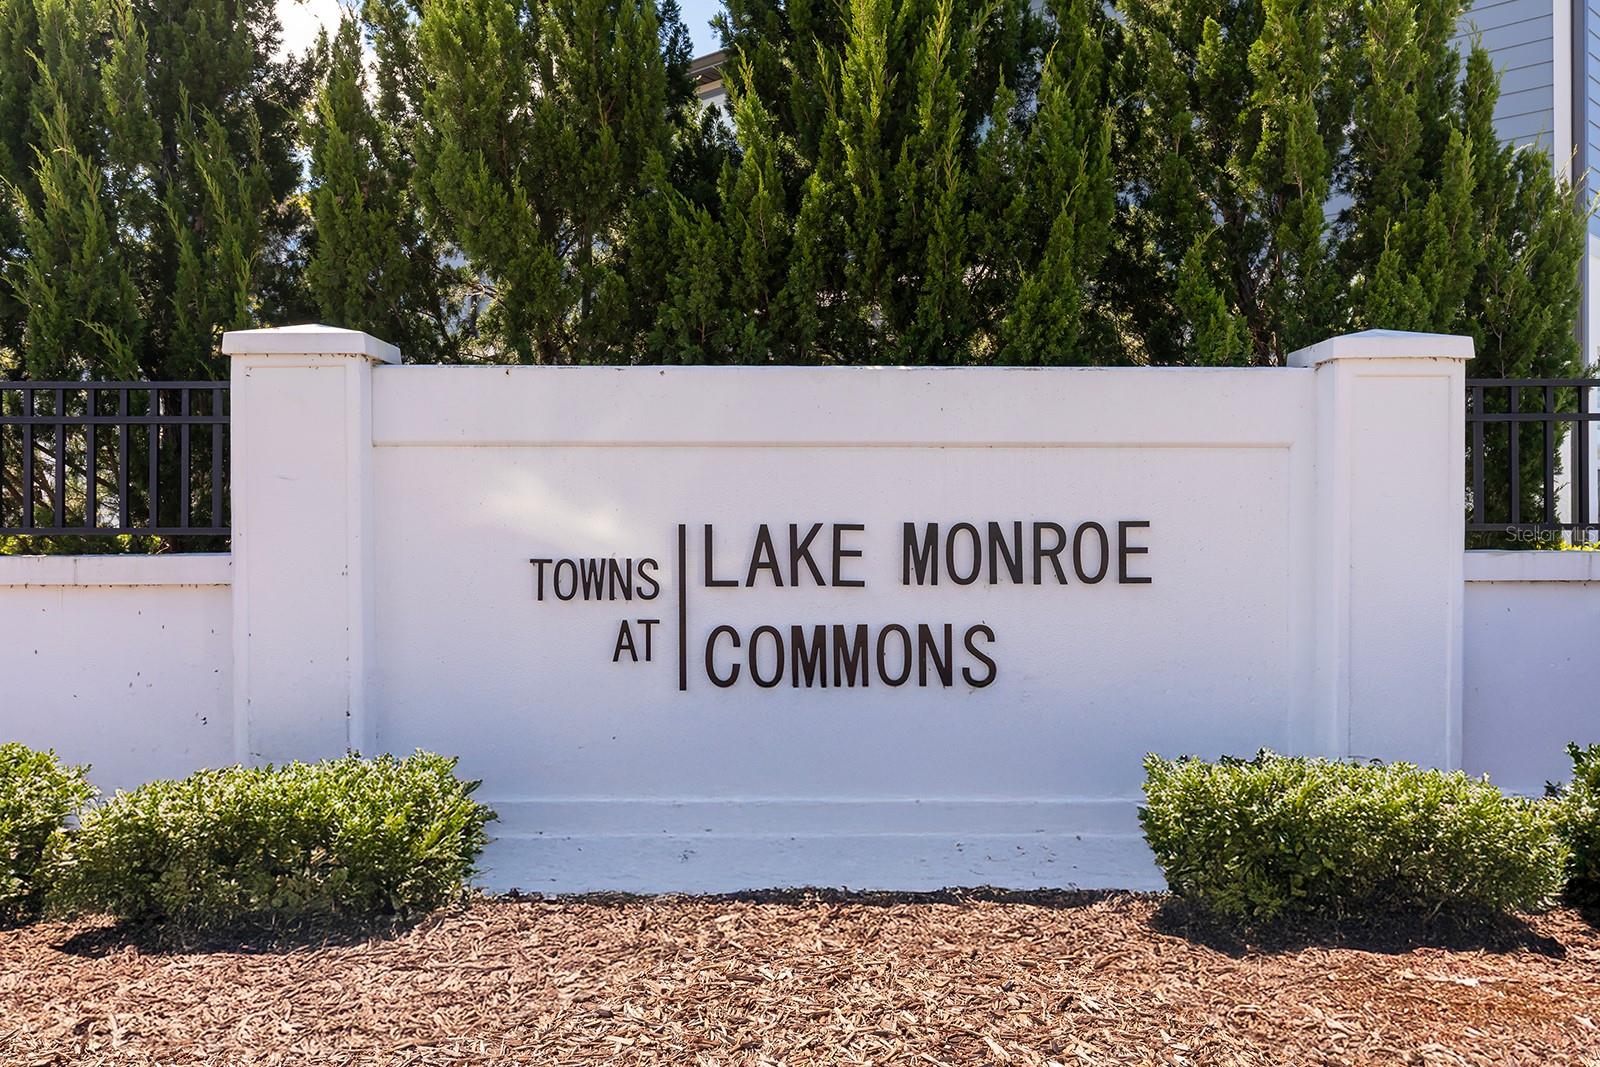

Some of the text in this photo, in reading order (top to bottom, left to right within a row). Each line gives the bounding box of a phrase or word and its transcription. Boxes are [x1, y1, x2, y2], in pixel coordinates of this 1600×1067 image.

[529, 558, 660, 602] TOWNS
[704, 521, 1153, 588] LAKE MONROE
[612, 619, 661, 663] AT
[704, 623, 998, 689] COMMONS
